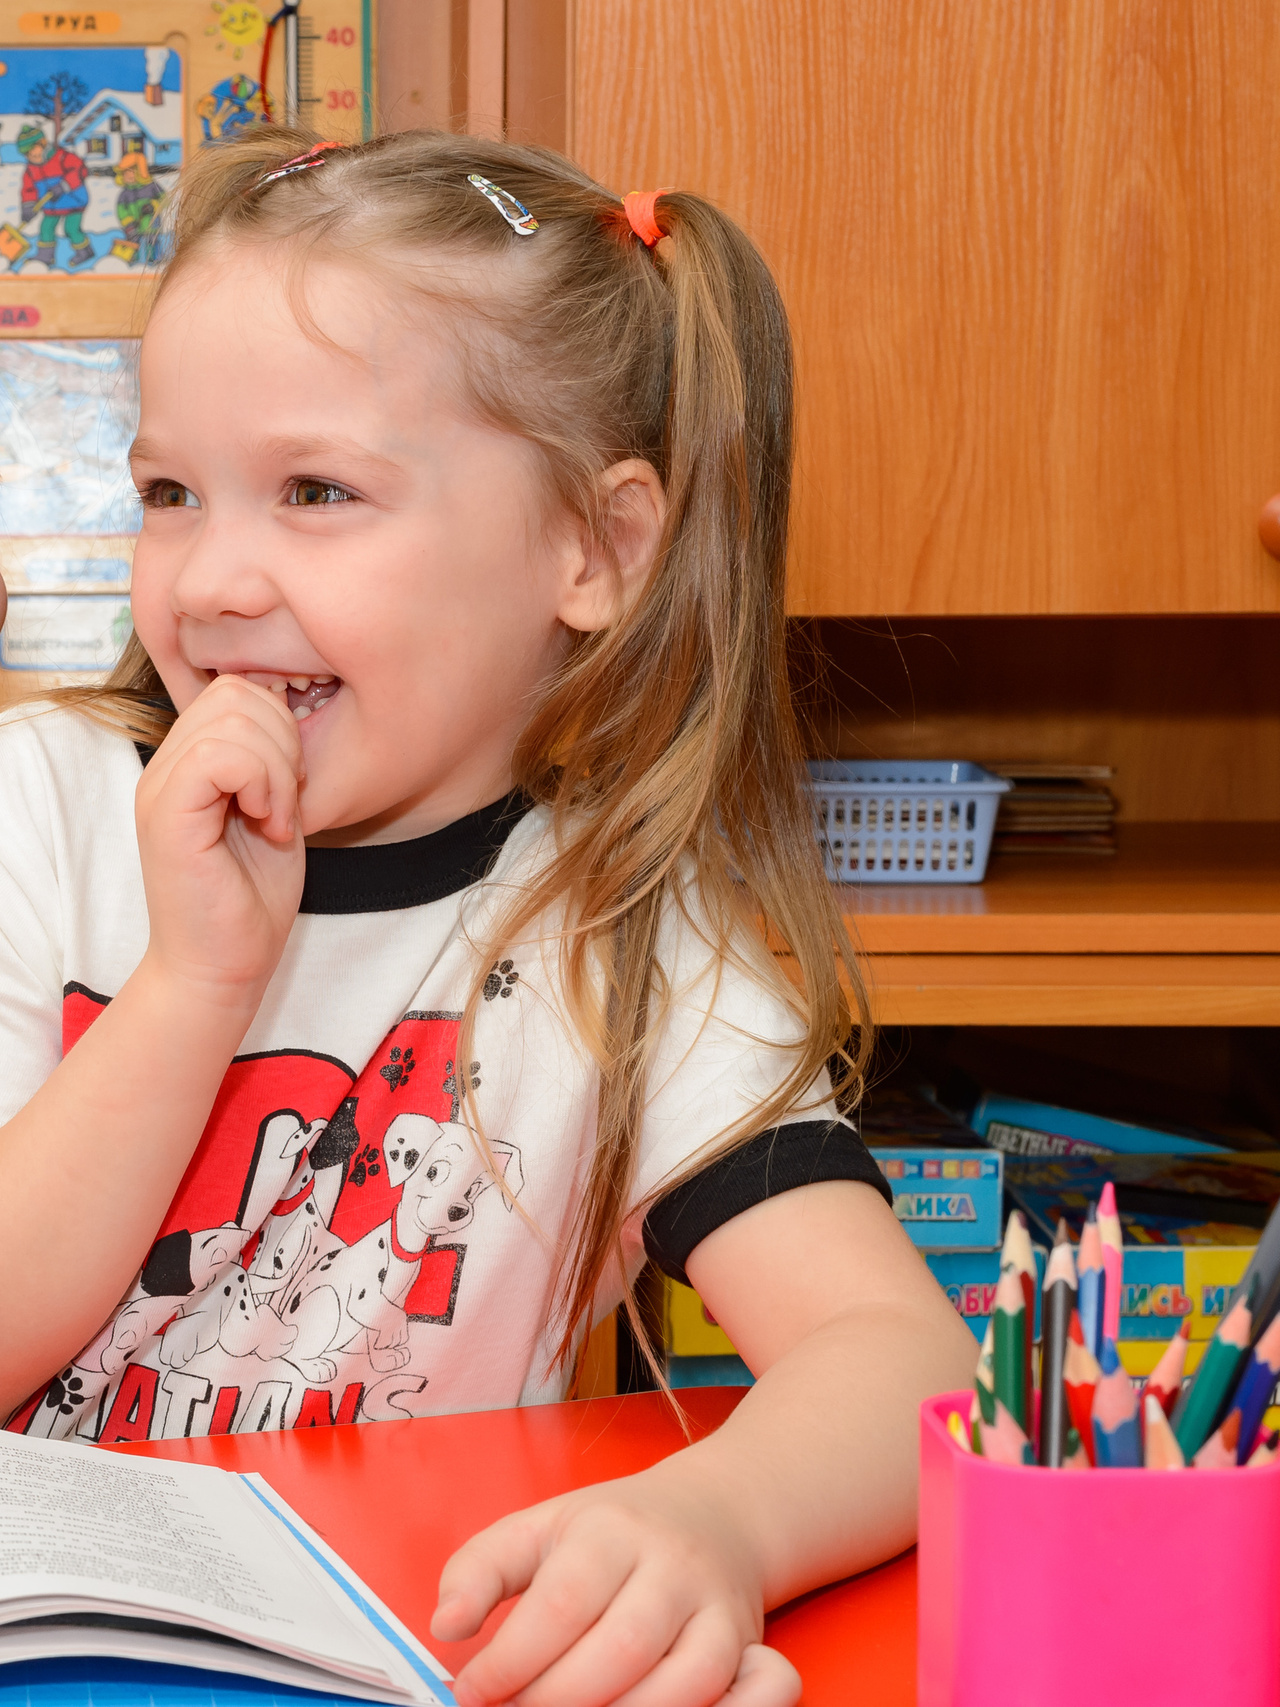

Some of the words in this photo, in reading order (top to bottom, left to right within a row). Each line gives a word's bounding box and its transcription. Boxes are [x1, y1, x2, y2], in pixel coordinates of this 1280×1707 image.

[42, 15, 98, 31] ТРУД
[326, 27, 356, 47] 40
[327, 90, 356, 110] 30
[893, 1192, 977, 1221] АИКА
[1121, 1283, 1192, 1318] ИСЬ
